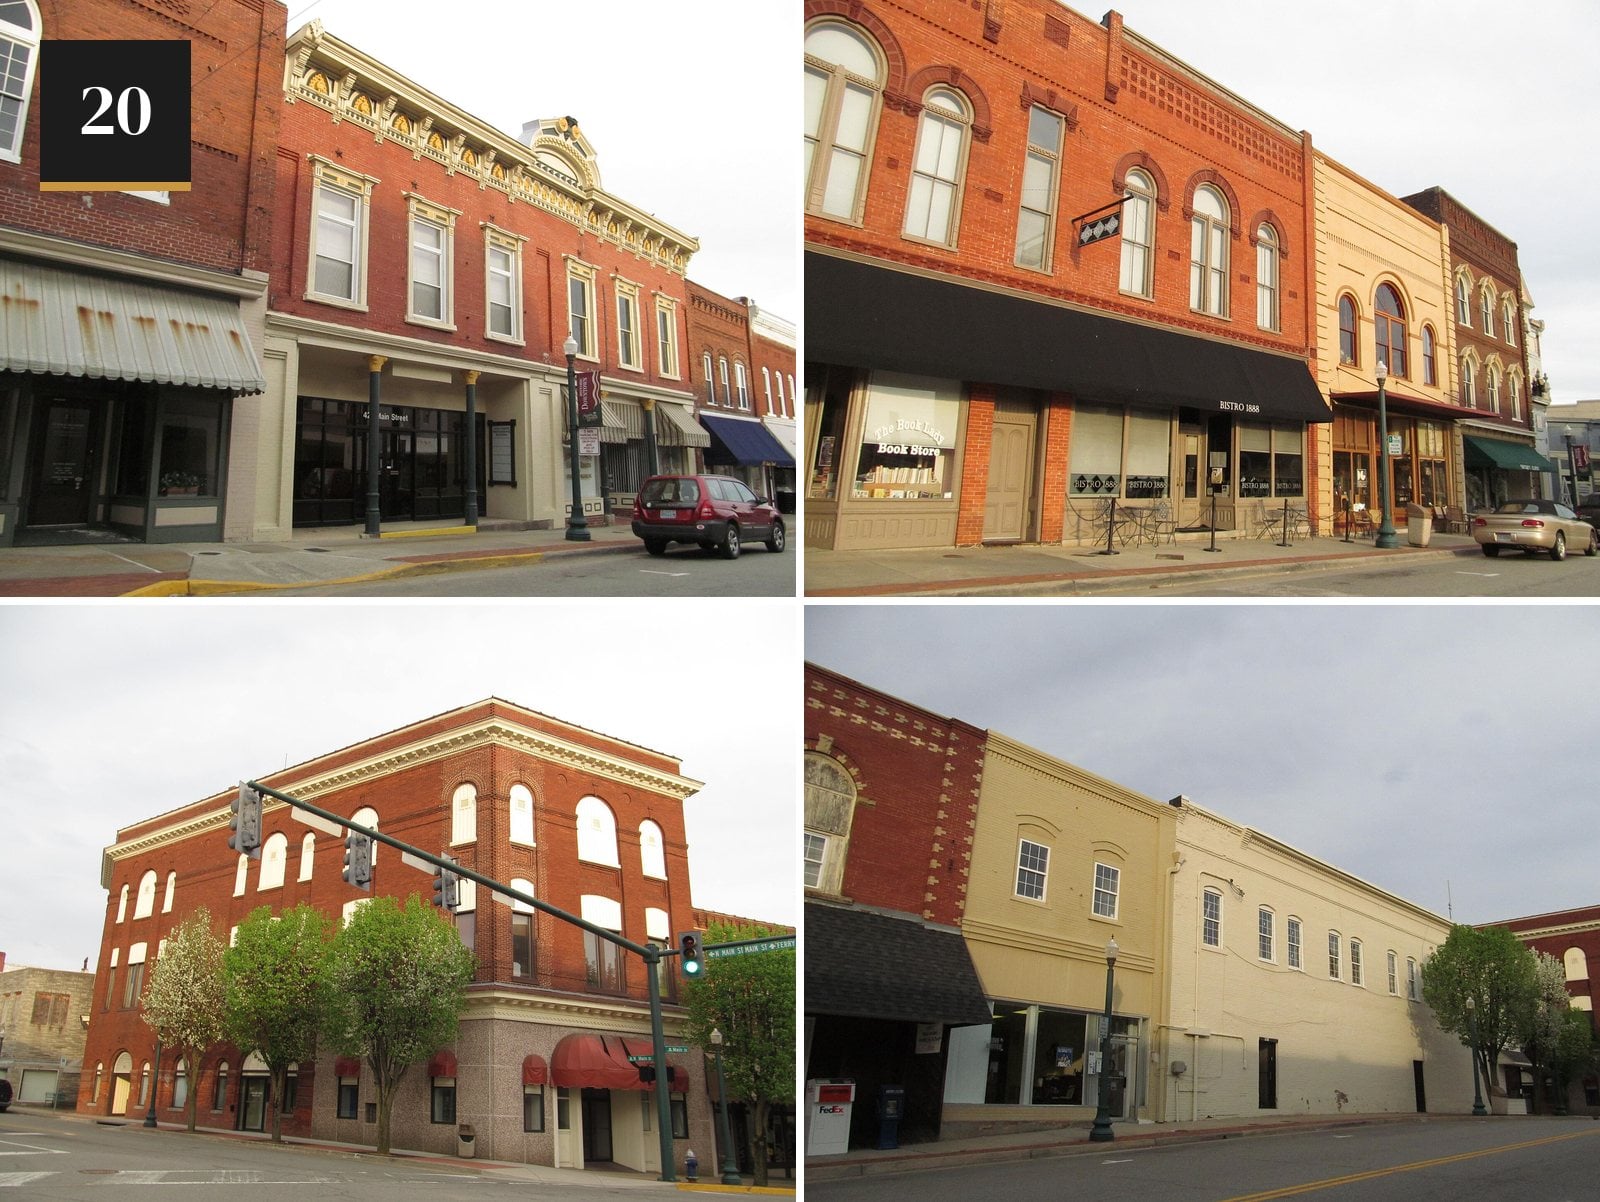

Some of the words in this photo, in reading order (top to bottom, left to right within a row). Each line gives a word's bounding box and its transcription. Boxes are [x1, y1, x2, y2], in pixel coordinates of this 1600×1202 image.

[1220, 400, 1245, 411] BISTRO
[1246, 403, 1260, 413] 1888
[390, 413, 409, 422] Street
[874, 424, 894, 441] The
[896, 419, 922, 432] Book
[923, 421, 945, 446] Lady
[877, 442, 909, 455] Book
[910, 444, 941, 456] Store
[1073, 480, 1101, 489] BISTRO
[1128, 480, 1153, 489] BISTRO
[744, 945, 759, 953] MAIN
[761, 943, 768, 951] ST
[777, 940, 795, 949] FERRY
[721, 948, 736, 957] MAIN
[819, 1105, 844, 1114] FedEx
